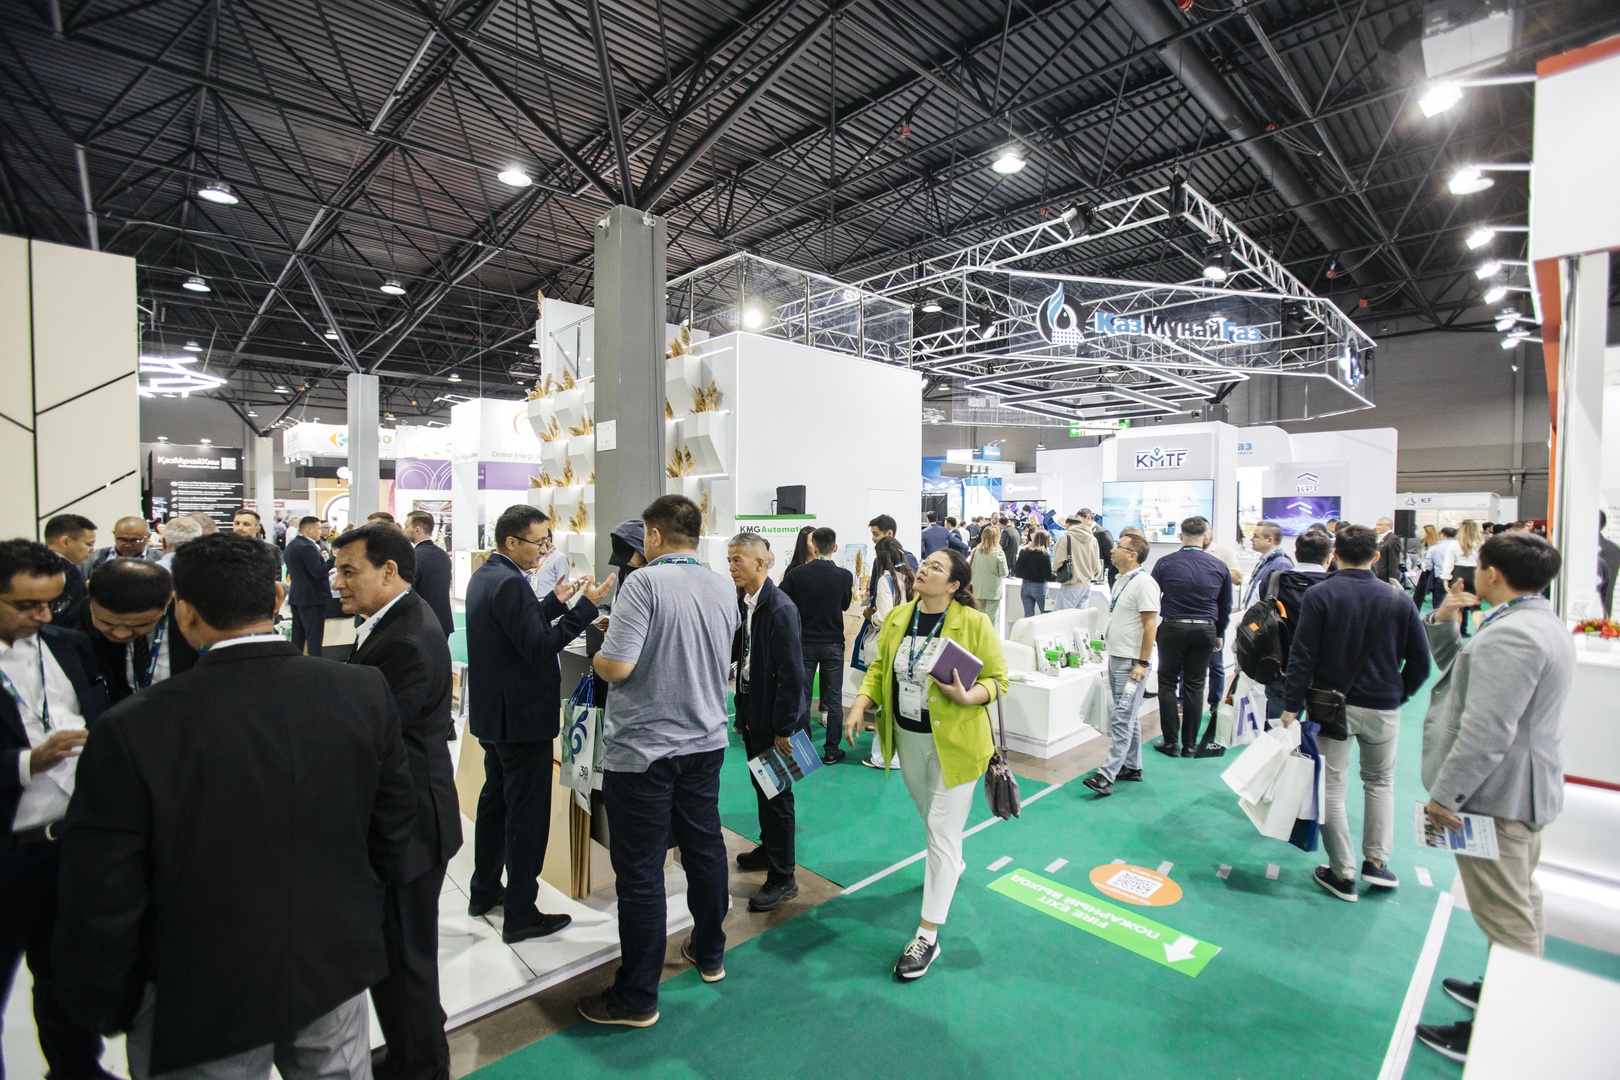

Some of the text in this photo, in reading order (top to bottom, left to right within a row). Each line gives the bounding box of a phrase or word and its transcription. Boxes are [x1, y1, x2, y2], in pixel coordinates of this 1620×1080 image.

[514, 452, 535, 460] Energy
[1136, 452, 1188, 468] KMTF
[1297, 485, 1317, 493] KPI
[740, 525, 802, 533] KMGAutomati
[1010, 874, 1161, 940] ПОЖАРНЫЙ ВЫХОД
[1036, 895, 1109, 929] FIRE EXIT
